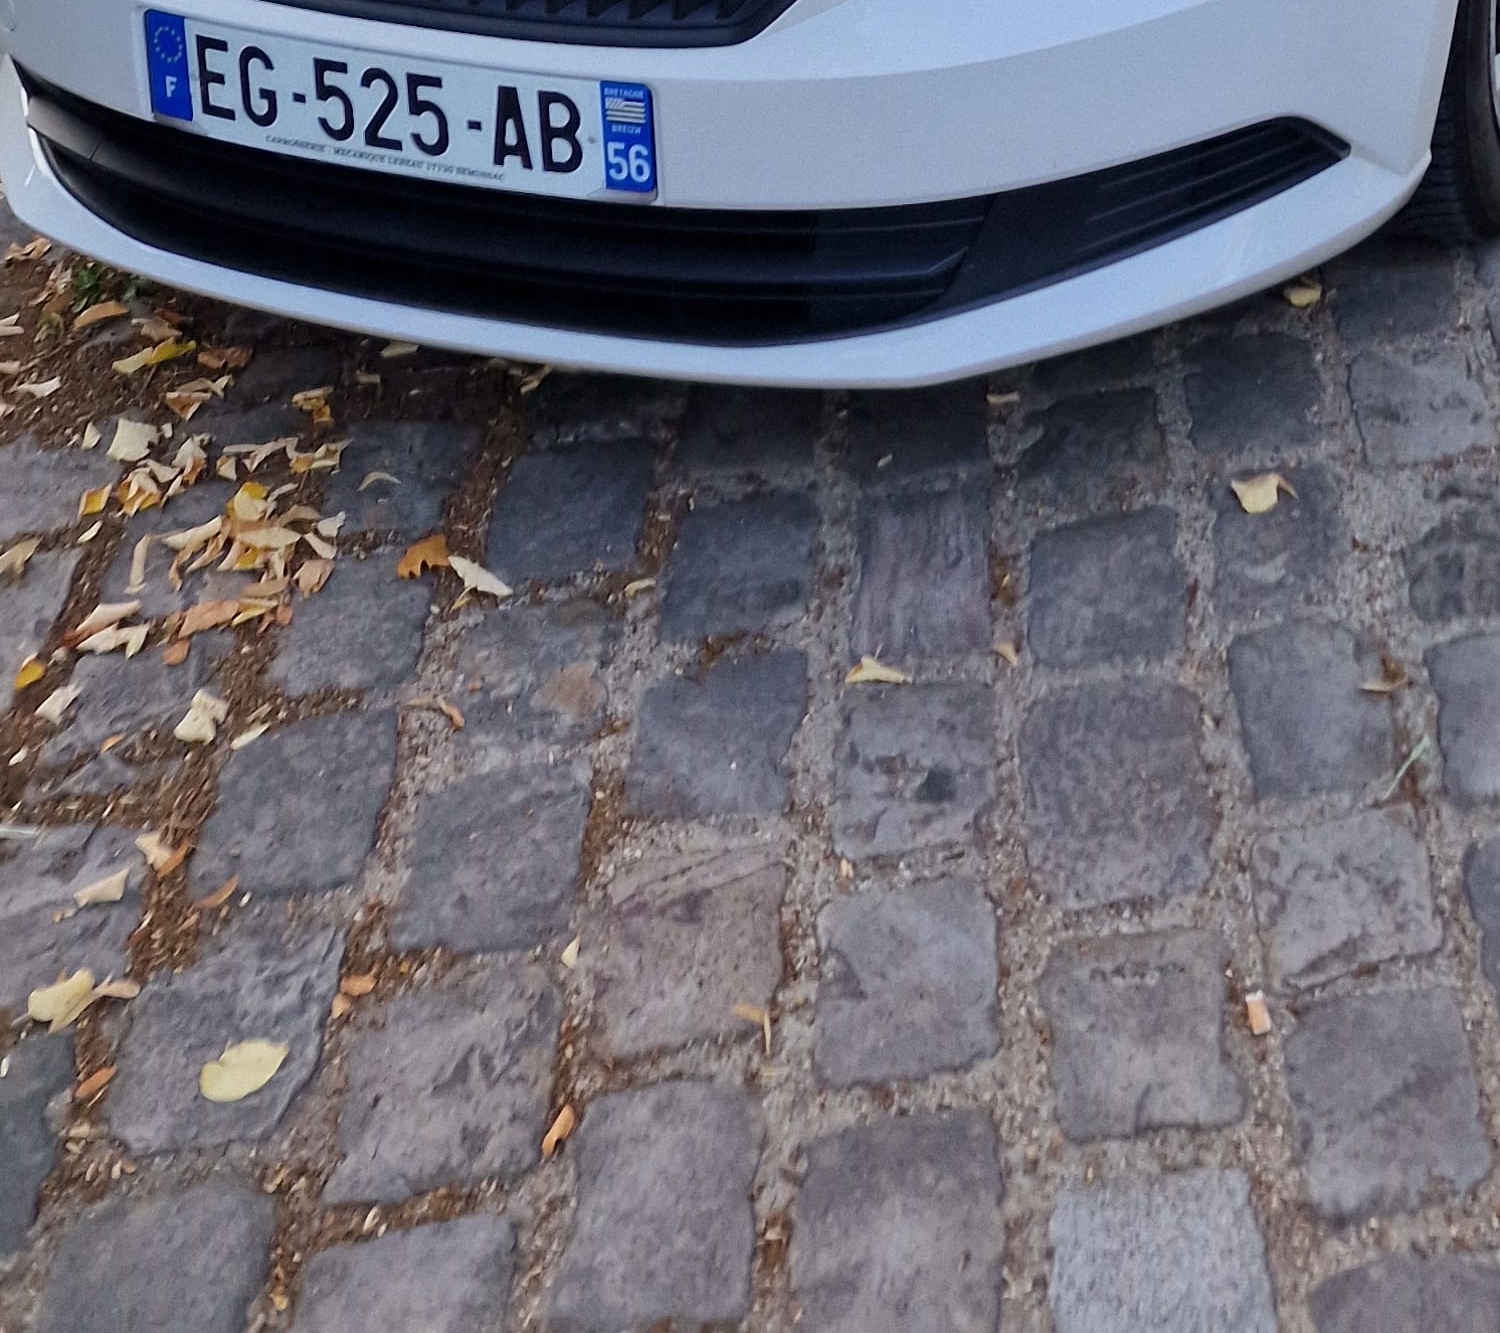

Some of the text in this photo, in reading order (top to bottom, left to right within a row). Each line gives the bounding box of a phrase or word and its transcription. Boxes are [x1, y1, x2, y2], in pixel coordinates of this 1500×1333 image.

[165, 75, 177, 98] F
[195, 34, 584, 173] EG-525-AB
[606, 141, 651, 183] 56
